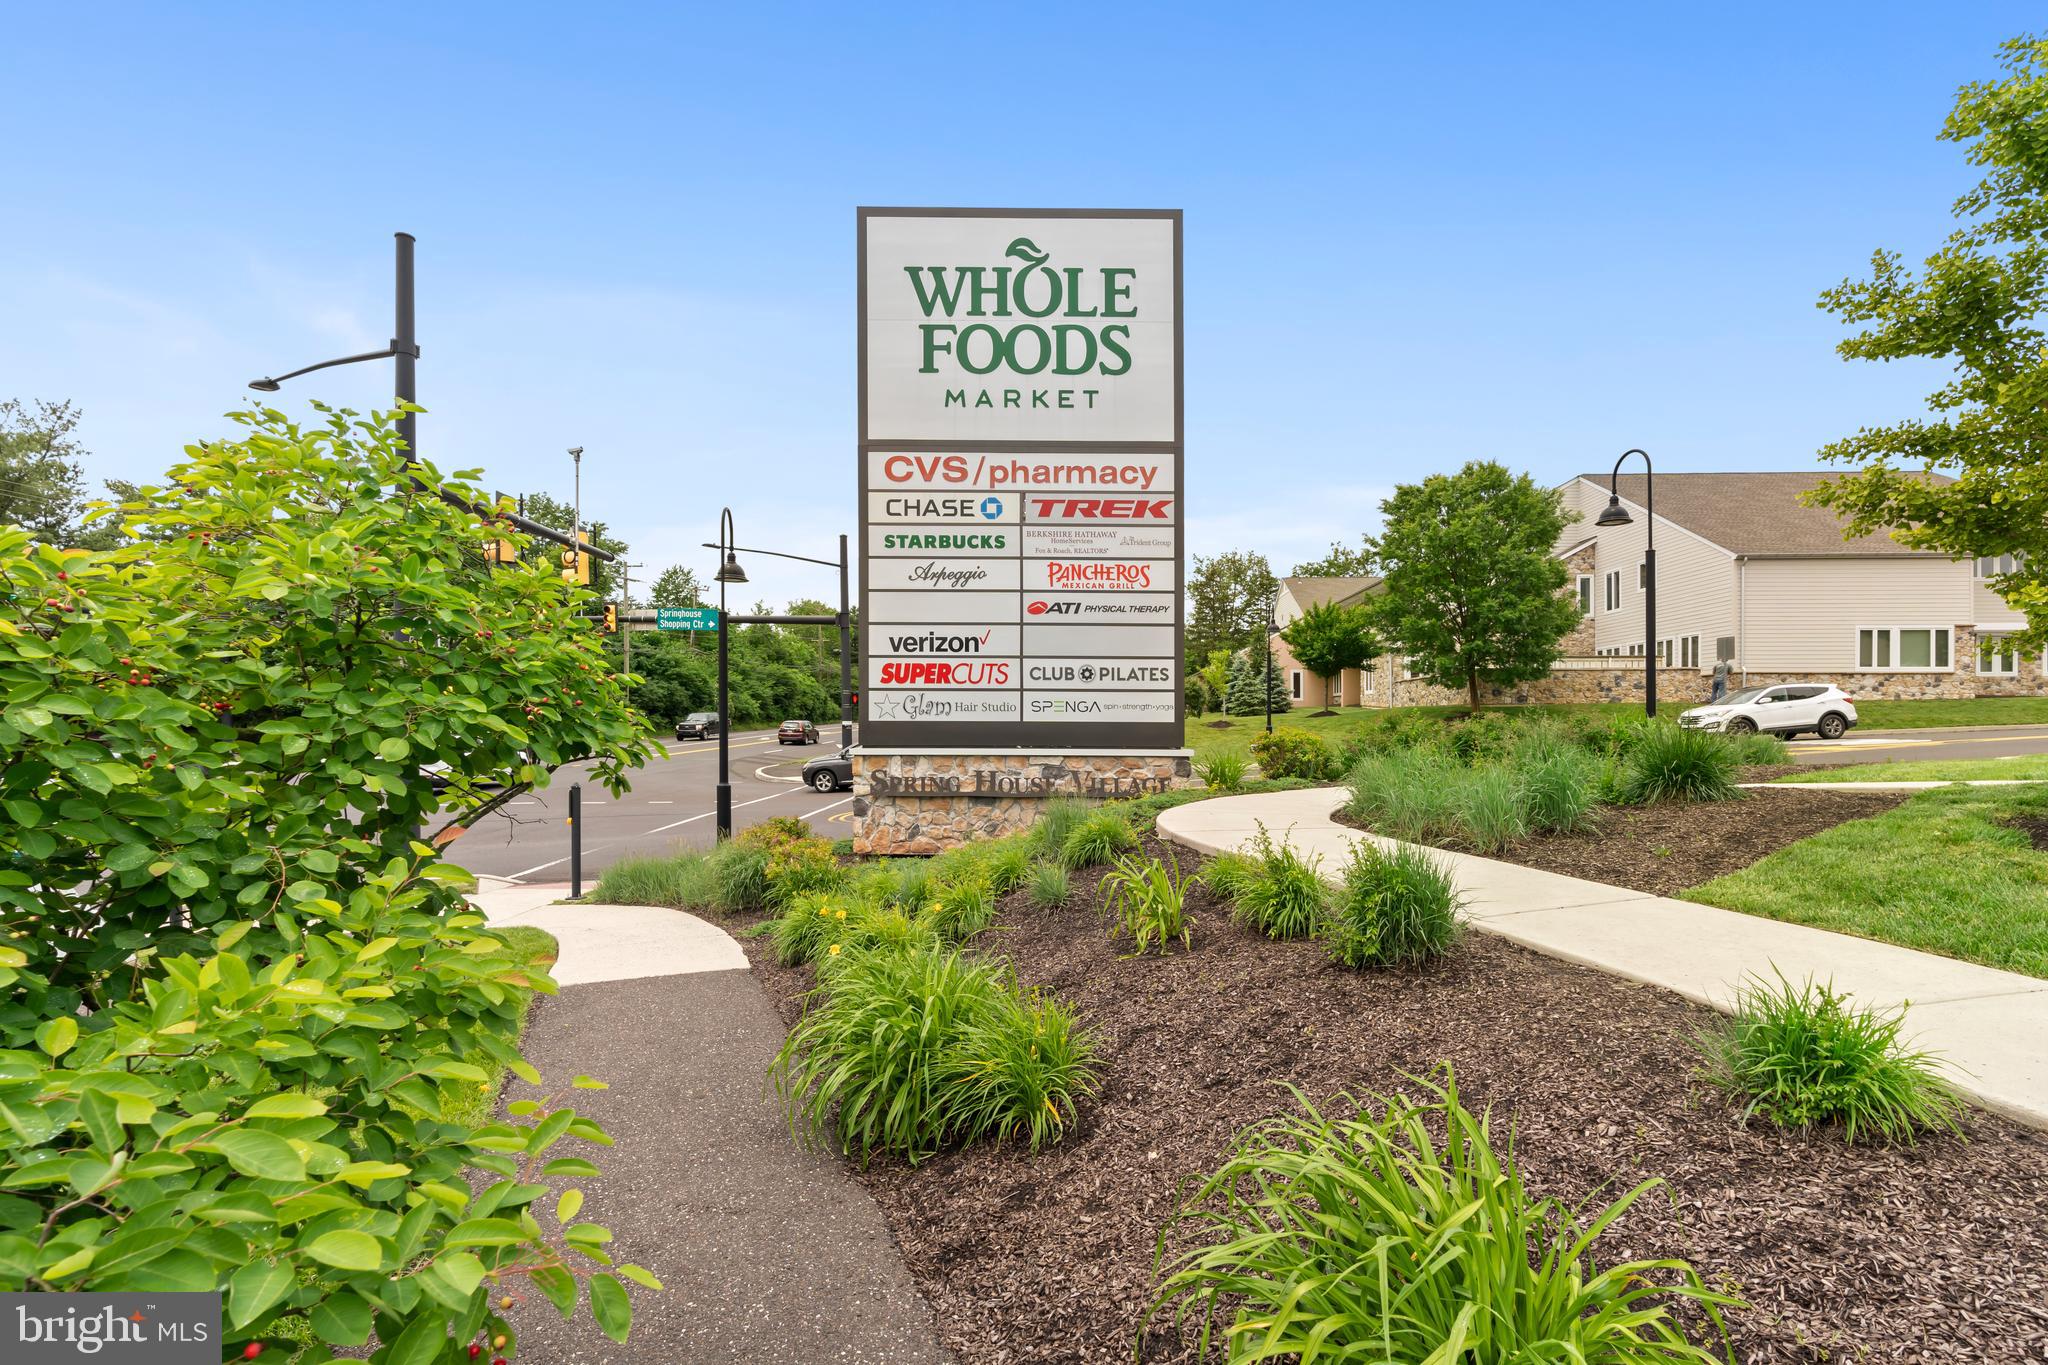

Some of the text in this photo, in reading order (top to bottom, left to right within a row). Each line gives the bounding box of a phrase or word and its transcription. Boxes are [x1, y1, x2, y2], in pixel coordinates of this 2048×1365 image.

[903, 265, 1138, 318] WHOLE
[918, 323, 1132, 376] FOODS
[944, 388, 1099, 408] MARKET
[884, 455, 1158, 489] CVS/pharmacy
[886, 498, 975, 518] CHASE
[1031, 499, 1175, 519] TREK
[884, 534, 1006, 550] STARBUCKS
[1026, 530, 1118, 539] BERKSHIRE HATHAWAY
[1050, 537, 1094, 545] HomeServices
[1129, 539, 1172, 548] Trident Group
[908, 561, 988, 588] Arpeggio
[1061, 582, 1135, 590] MEXICAN GRILL
[659, 609, 702, 618] Springhouse
[1046, 602, 1170, 614] ATI PHYSICAL THERAPY
[659, 620, 704, 629] Shopping Ctr
[889, 631, 979, 653] verizon
[880, 662, 1009, 685] SUPERCUTS
[1029, 667, 1170, 682] CLUB PILATES
[903, 693, 1017, 719] Glam Hair Studio
[1031, 700, 1101, 713] SPENGA
[870, 769, 961, 799] SPRING
